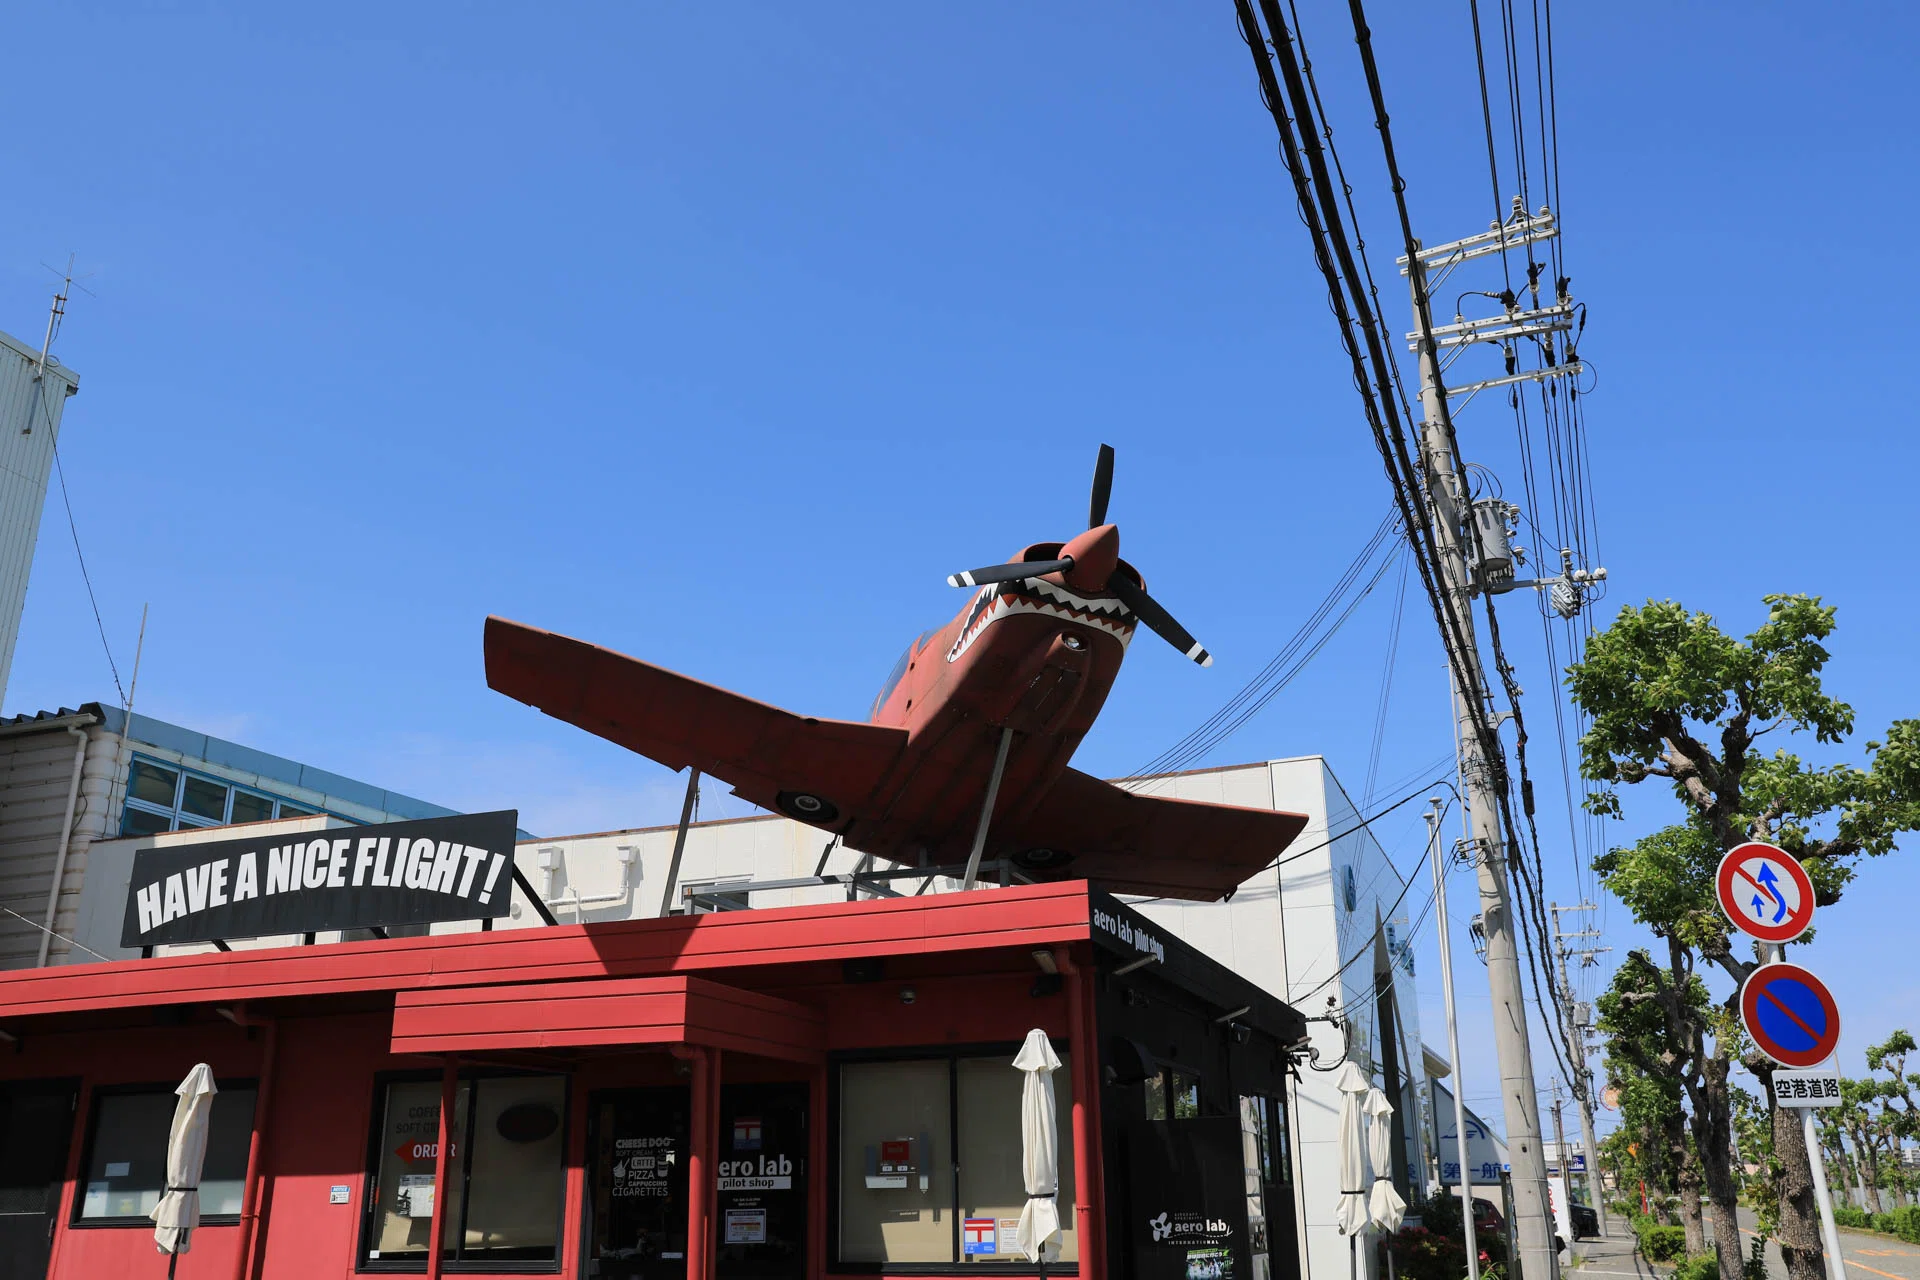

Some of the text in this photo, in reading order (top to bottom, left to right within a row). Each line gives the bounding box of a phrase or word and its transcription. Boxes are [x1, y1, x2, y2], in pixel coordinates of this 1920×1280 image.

[137, 837, 505, 934] HAVE A NICE FLIGHT!
[1094, 908, 1164, 964] aero lab pilot shop
[1775, 1078, 1839, 1098] 空港道路
[615, 1136, 671, 1149] CHEESE DOG
[412, 1143, 456, 1159] ORDR
[632, 1158, 654, 1168] LATTE
[718, 1153, 793, 1177] ero lab
[628, 1170, 655, 1180] PIZZA
[722, 1178, 774, 1189] pilot shop
[612, 1187, 668, 1197] CIGARETTES
[1174, 1219, 1227, 1232] aero lab
